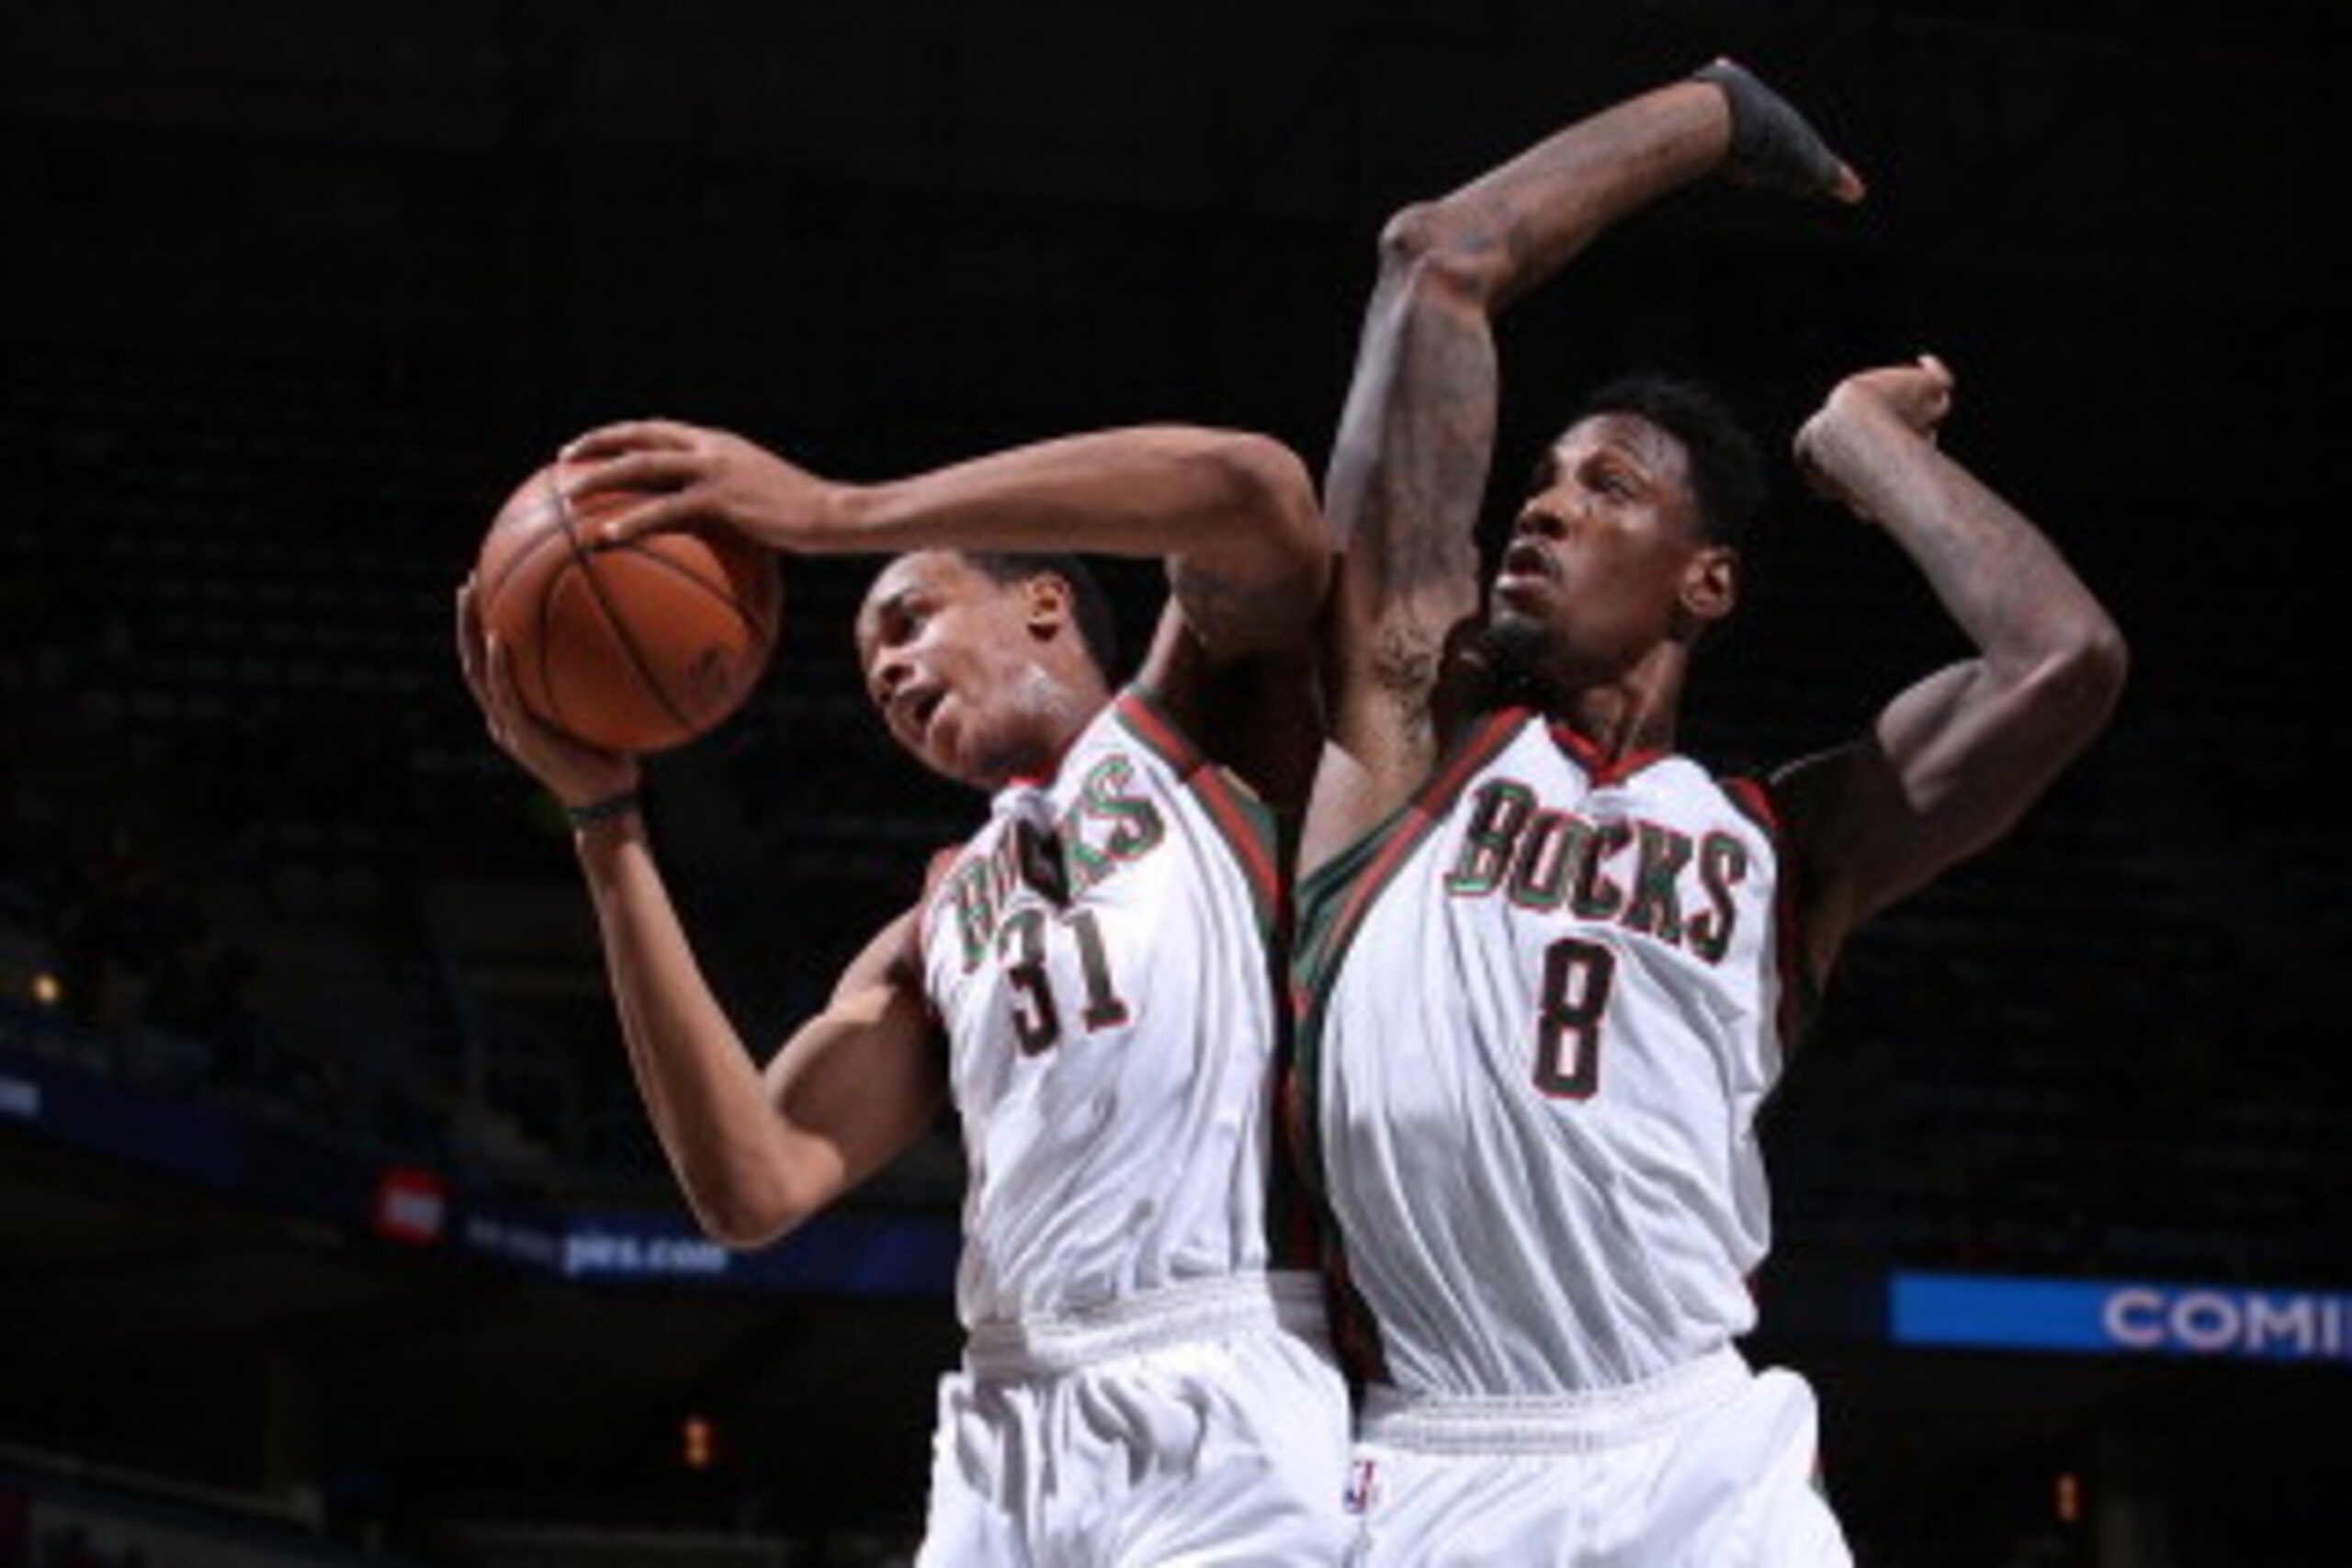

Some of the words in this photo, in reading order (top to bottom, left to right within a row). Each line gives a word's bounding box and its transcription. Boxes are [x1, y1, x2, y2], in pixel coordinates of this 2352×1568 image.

[1443, 778, 1747, 967] BUCKS
[997, 907, 1128, 1056] 31
[1532, 936, 1615, 1100] 8
